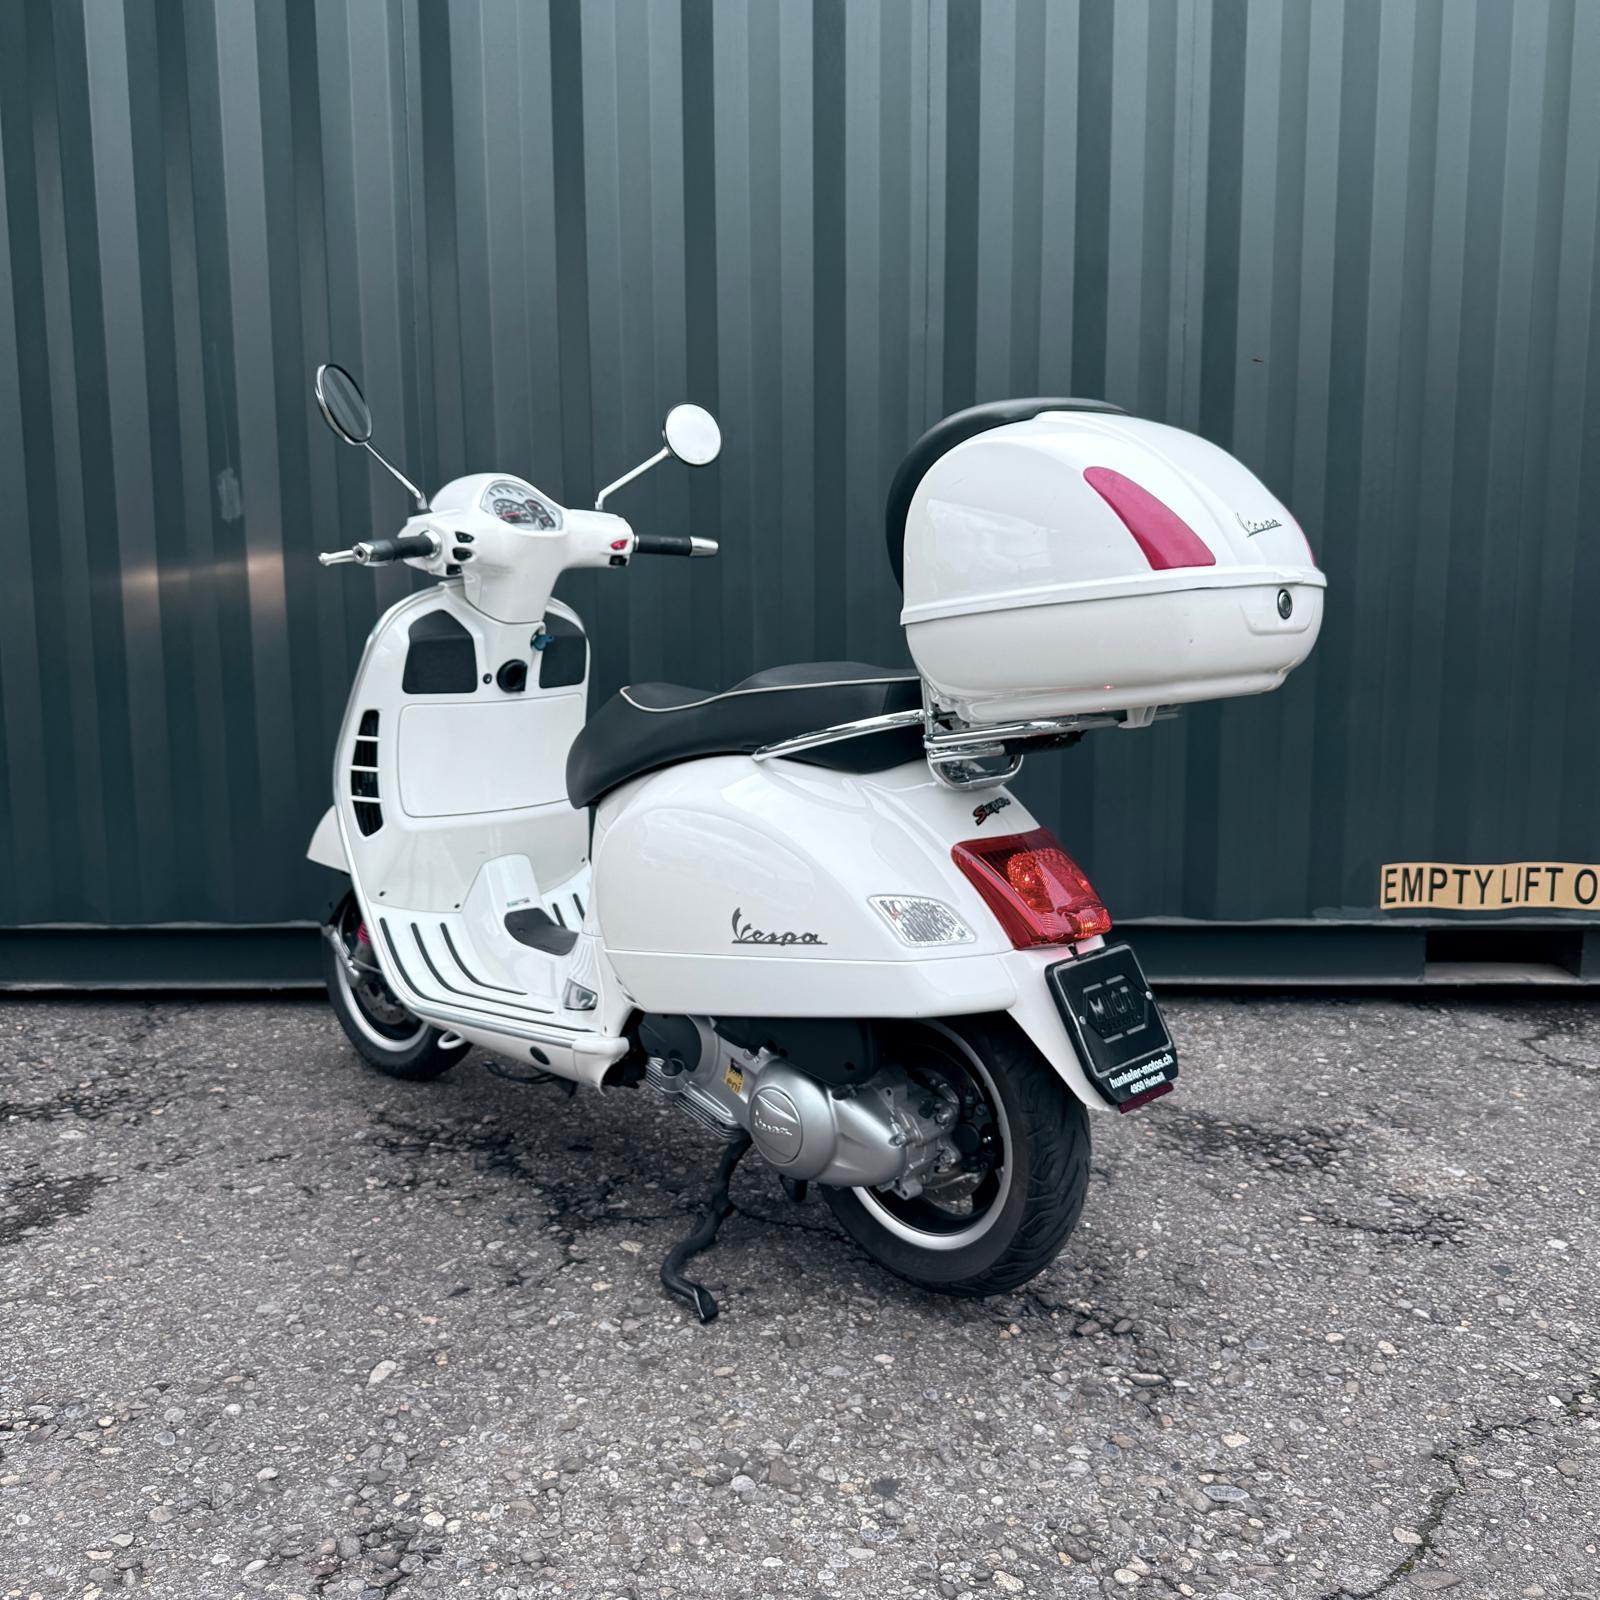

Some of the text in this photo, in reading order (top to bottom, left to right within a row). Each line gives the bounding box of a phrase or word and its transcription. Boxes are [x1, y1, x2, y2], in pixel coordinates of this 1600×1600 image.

[1235, 511, 1282, 538] Vespa
[1384, 867, 1494, 904] EMPTY
[1501, 867, 1564, 904] LIFT
[731, 907, 828, 946] Vespa
[727, 1078, 742, 1093] eni
[1108, 1053, 1174, 1089] hunkeler-motos.ch
[1130, 1080, 1146, 1094] 4950
